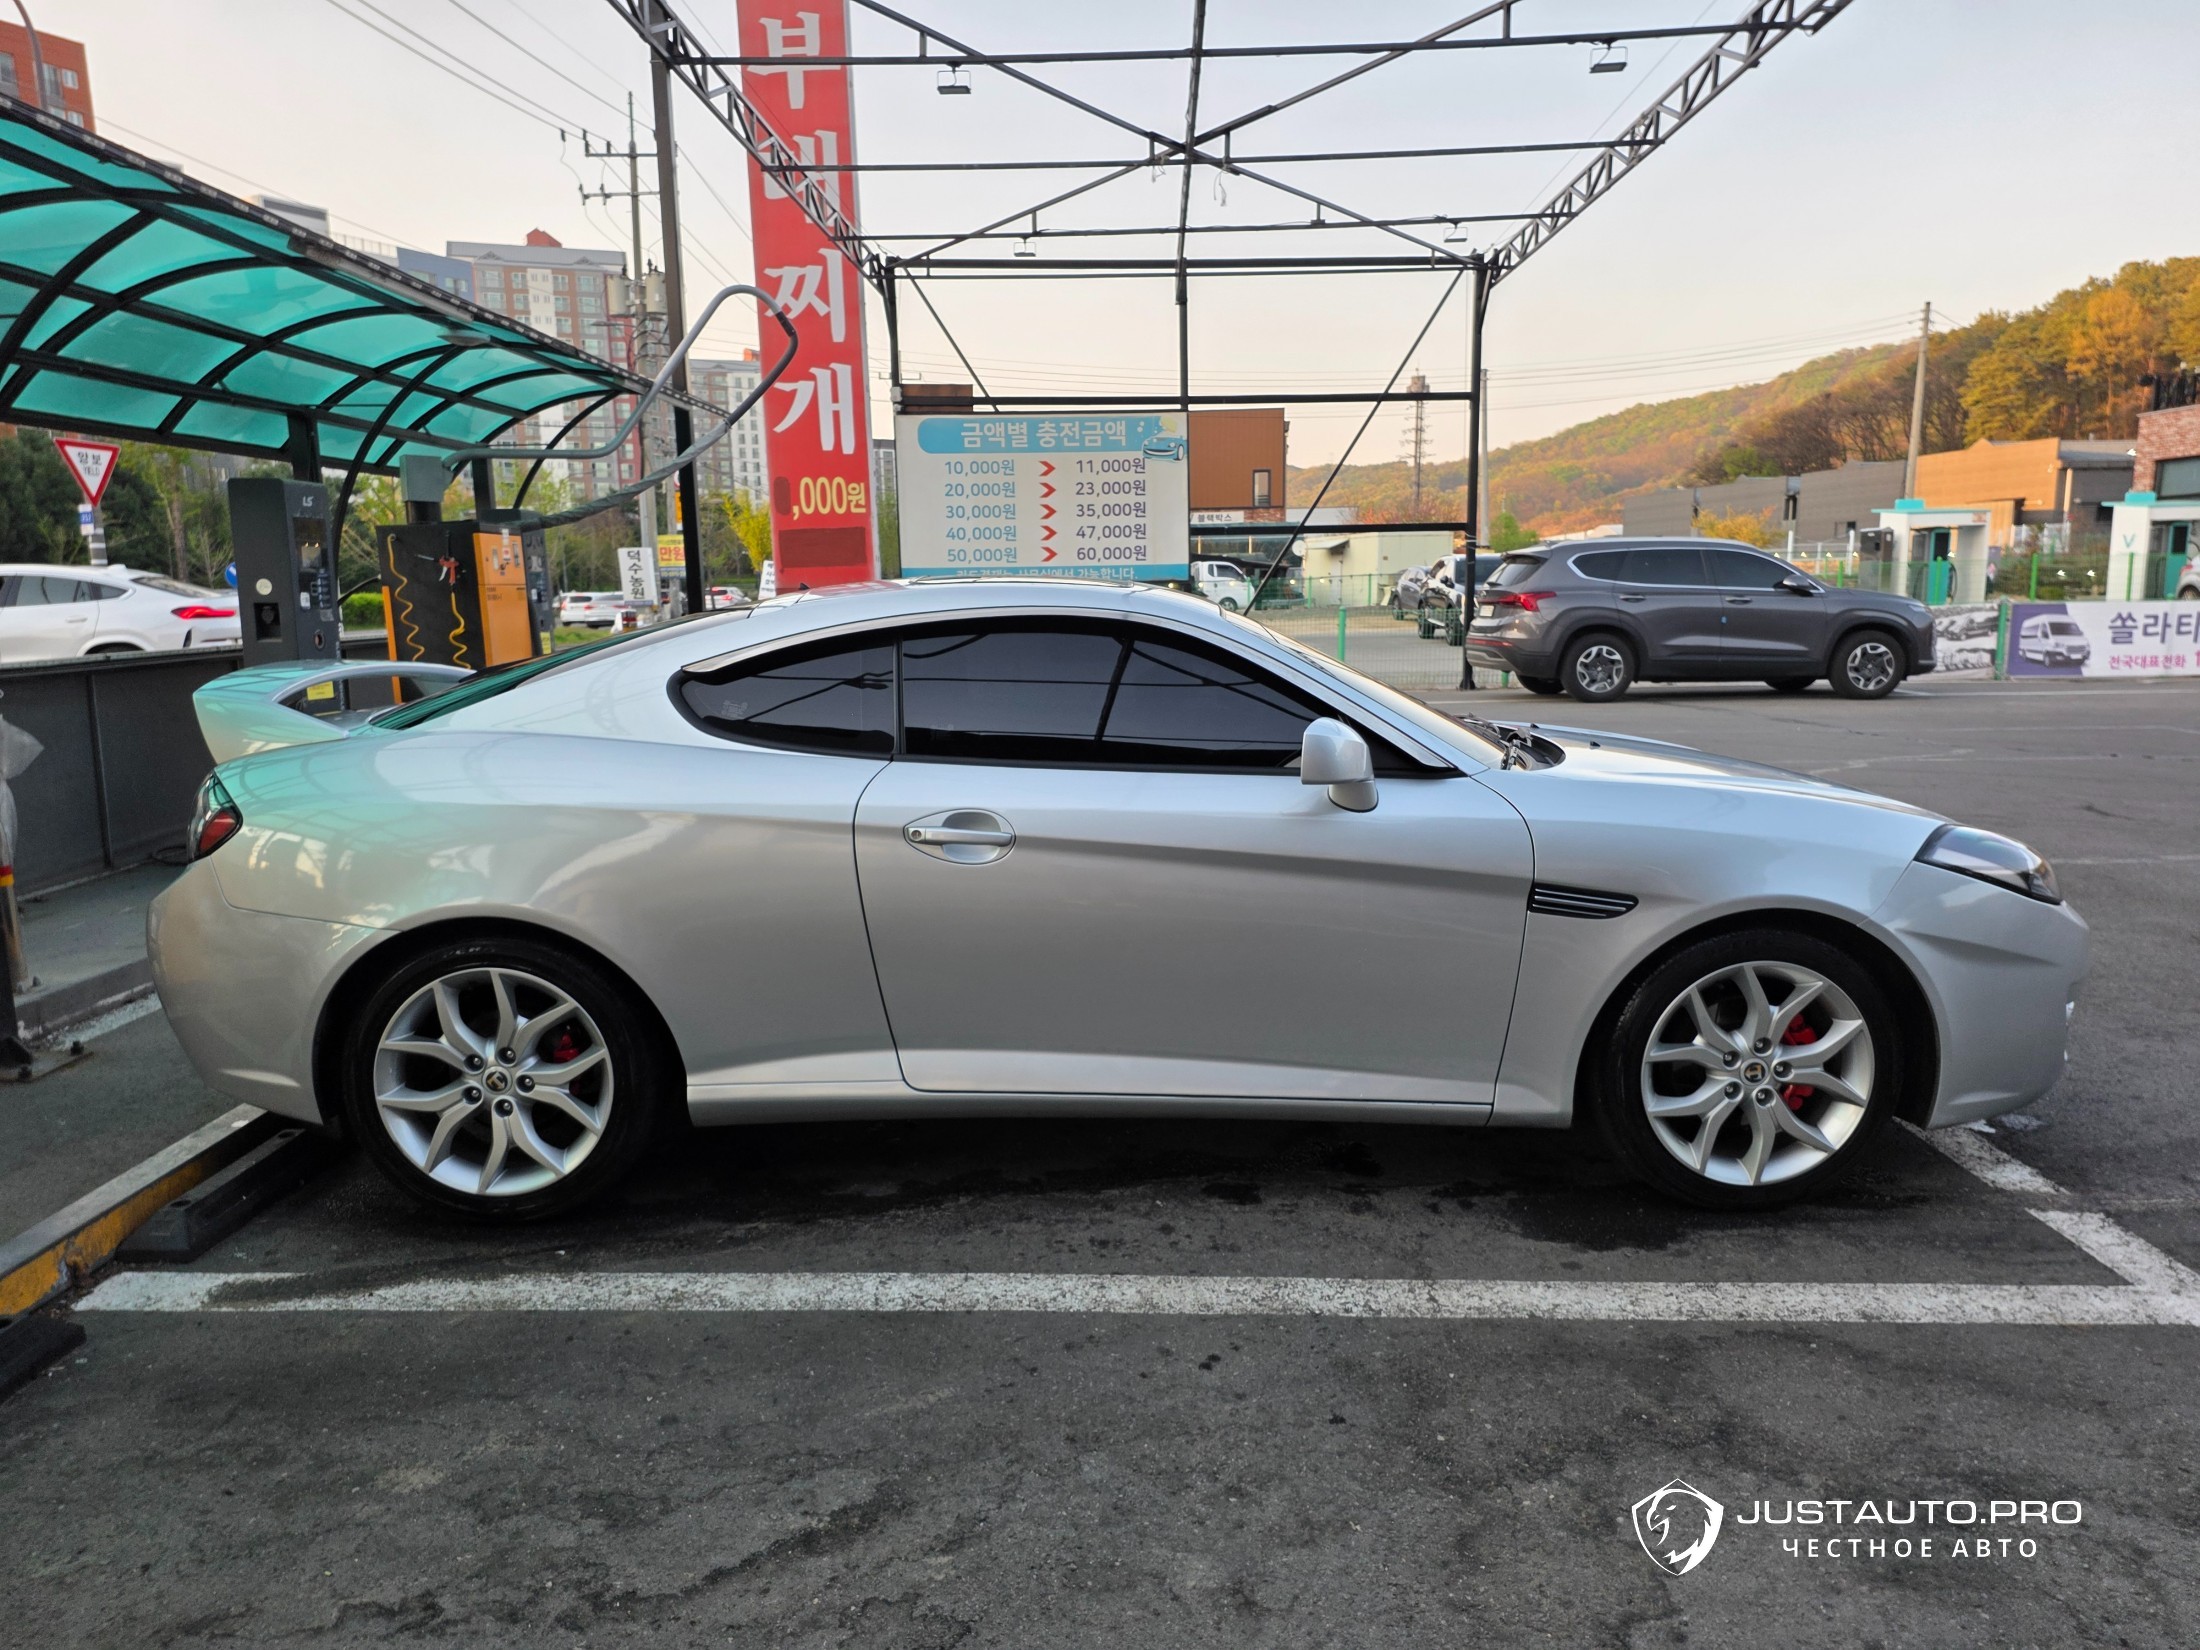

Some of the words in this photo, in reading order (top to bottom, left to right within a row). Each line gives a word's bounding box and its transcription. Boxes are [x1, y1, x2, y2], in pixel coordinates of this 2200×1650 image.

[747, 11, 855, 455] 부대찌개
[960, 421, 1029, 449] 금액별
[1036, 420, 1127, 448] 충전금액
[944, 459, 1016, 477] 10,000원
[1075, 457, 1147, 475] 11,000원
[944, 481, 1016, 499] 20,000원
[1075, 479, 1147, 498] 23,000원
[945, 503, 1016, 521] 30,000원
[1075, 501, 1147, 520] 35,000원
[945, 524, 1017, 543] 40,000원
[1075, 522, 1147, 542] 47,000원
[947, 546, 1018, 564] 50,000원
[1076, 544, 1148, 563] 60,000원
[627, 549, 646, 600] 덕수농원
